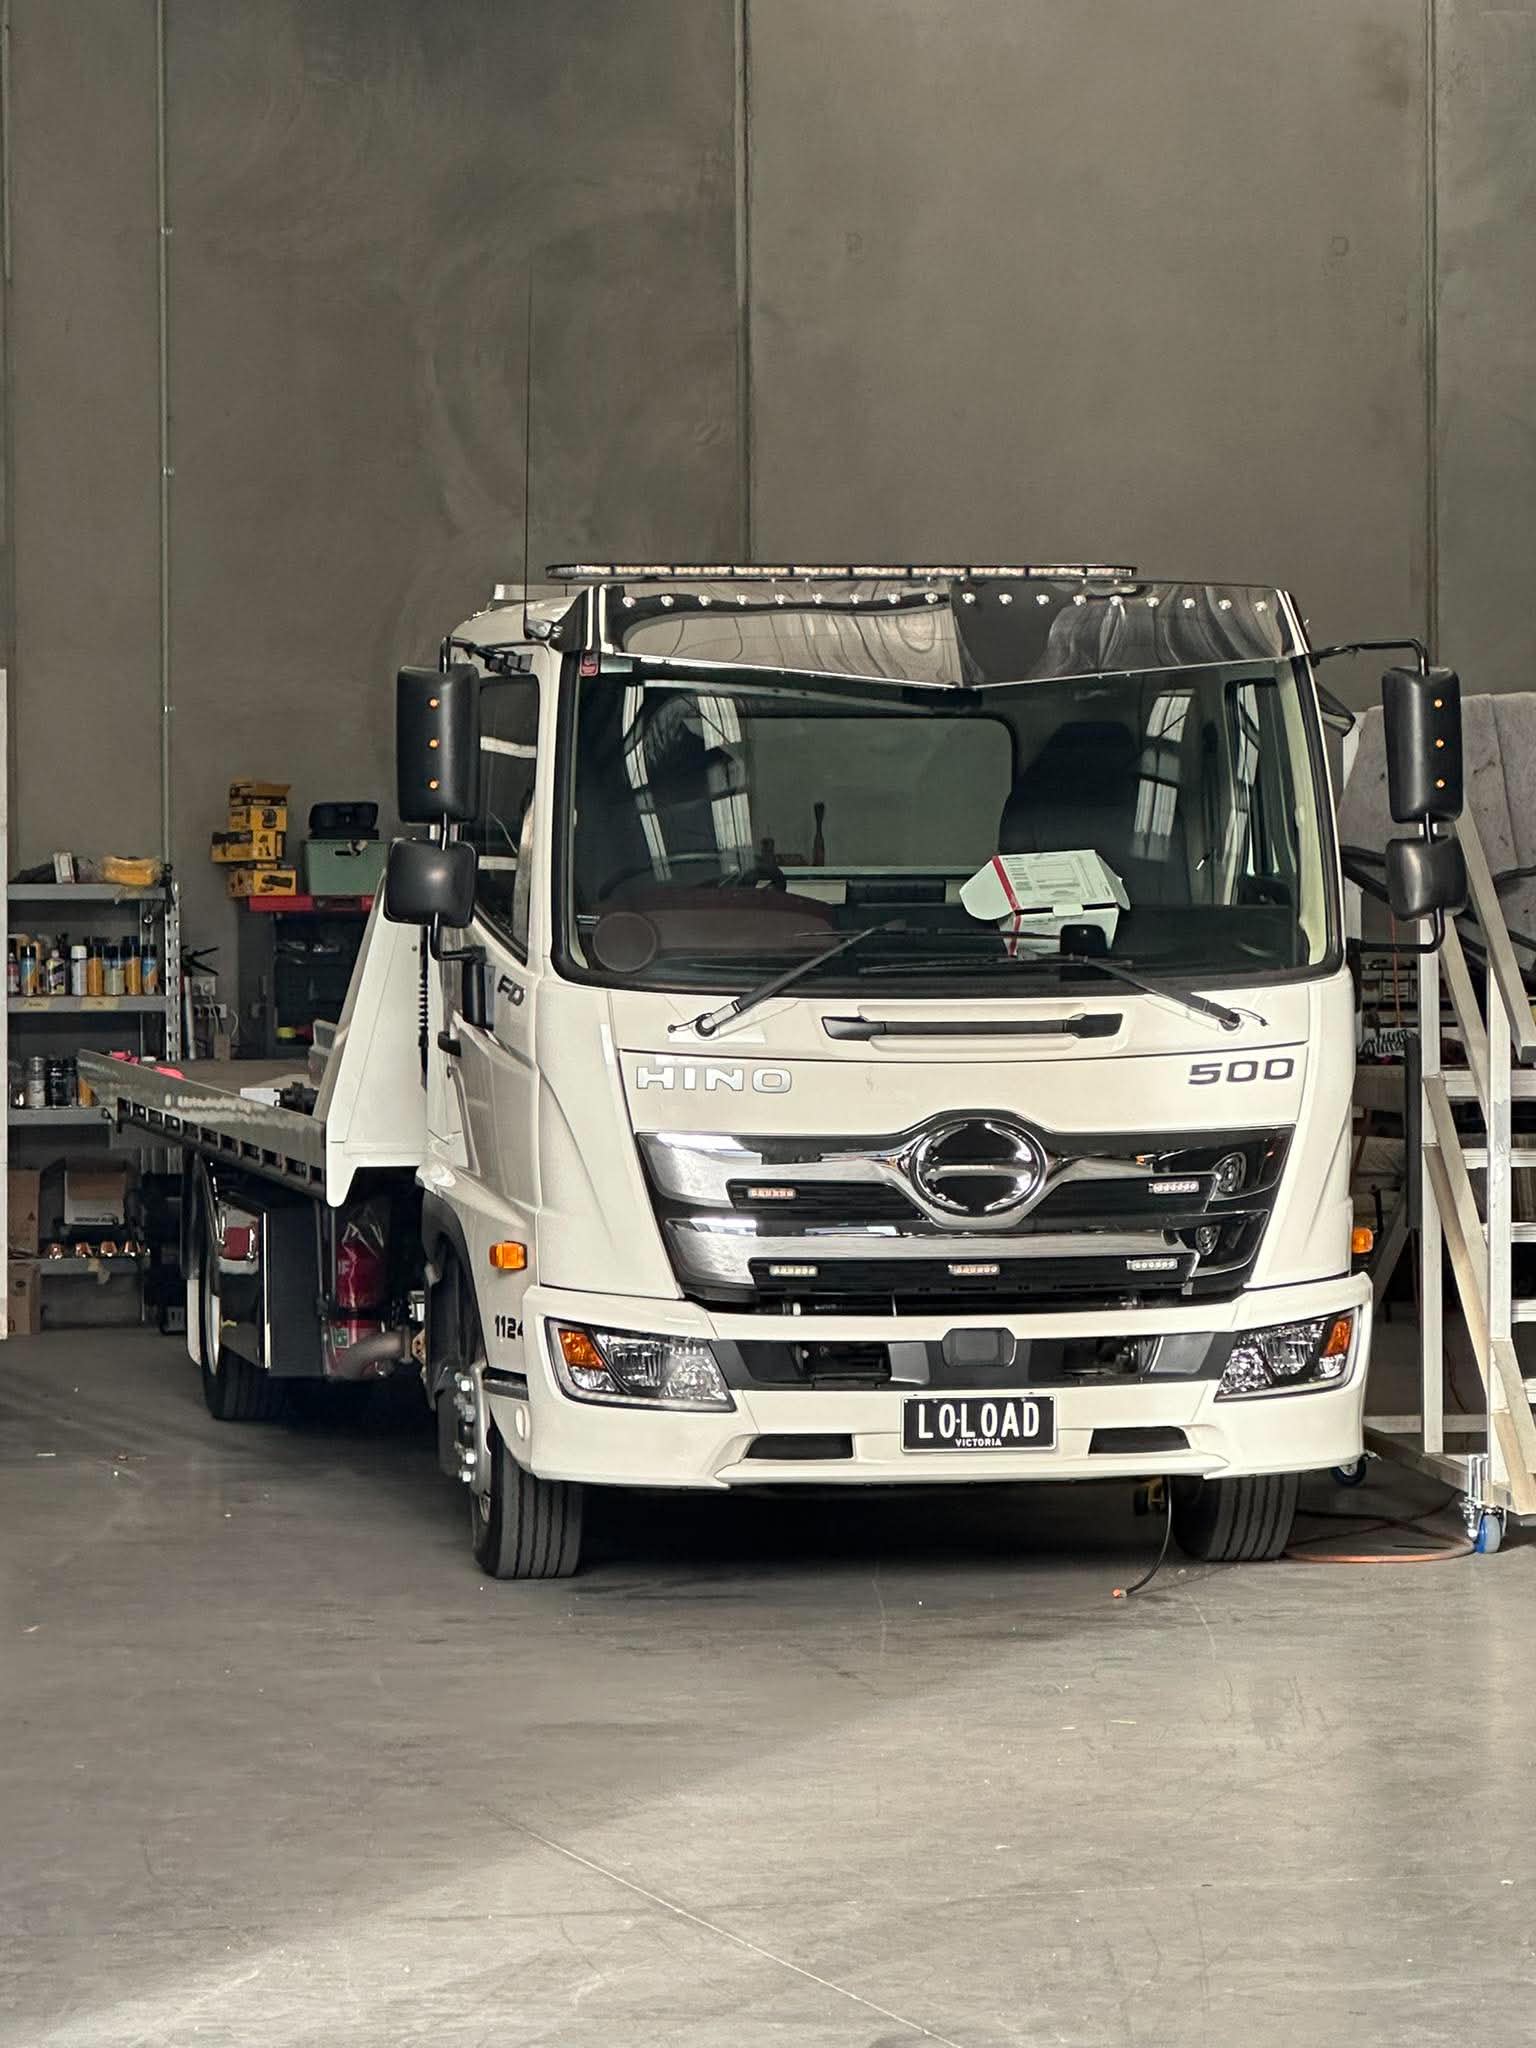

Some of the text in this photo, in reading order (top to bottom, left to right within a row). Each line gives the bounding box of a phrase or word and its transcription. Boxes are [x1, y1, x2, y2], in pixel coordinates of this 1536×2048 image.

[497, 974, 524, 1007] FD
[636, 1066, 793, 1093] HINO
[1188, 1058, 1294, 1085] 500
[955, 1438, 1003, 1448] VICTORIA
